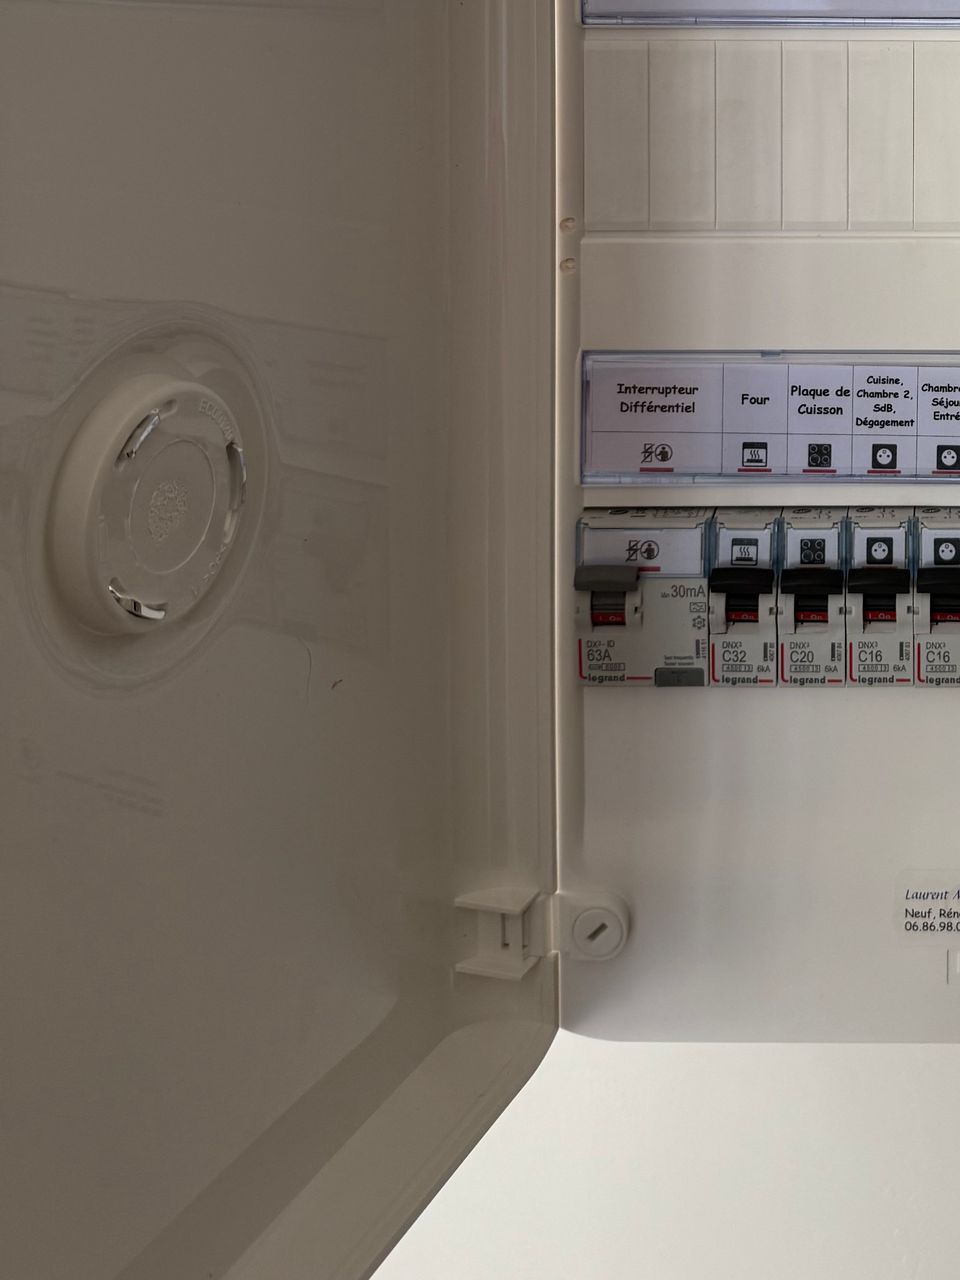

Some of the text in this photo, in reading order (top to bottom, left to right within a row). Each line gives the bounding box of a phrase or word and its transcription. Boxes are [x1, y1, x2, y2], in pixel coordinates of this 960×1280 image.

[866, 375, 904, 386] Cuisine,
[616, 383, 699, 397] Interrupteur
[790, 385, 851, 399] Plaque de
[856, 389, 913, 400] Chambre 2,
[741, 394, 770, 405] Four
[620, 402, 696, 414] Différentiel
[797, 404, 843, 415] Cuisson
[873, 403, 896, 414] SdB,
[855, 417, 915, 429] Dégagement
[587, 649, 612, 661] 63A
[722, 650, 747, 662] C32
[790, 650, 814, 662] C20
[858, 650, 882, 662] C16
[926, 651, 950, 663] C16
[588, 673, 626, 683] legrand
[722, 675, 758, 685] legrand
[790, 675, 826, 685] legrand
[858, 675, 894, 685] legrand
[905, 889, 948, 900] Laurent
[905, 908, 936, 920] Neuf,
